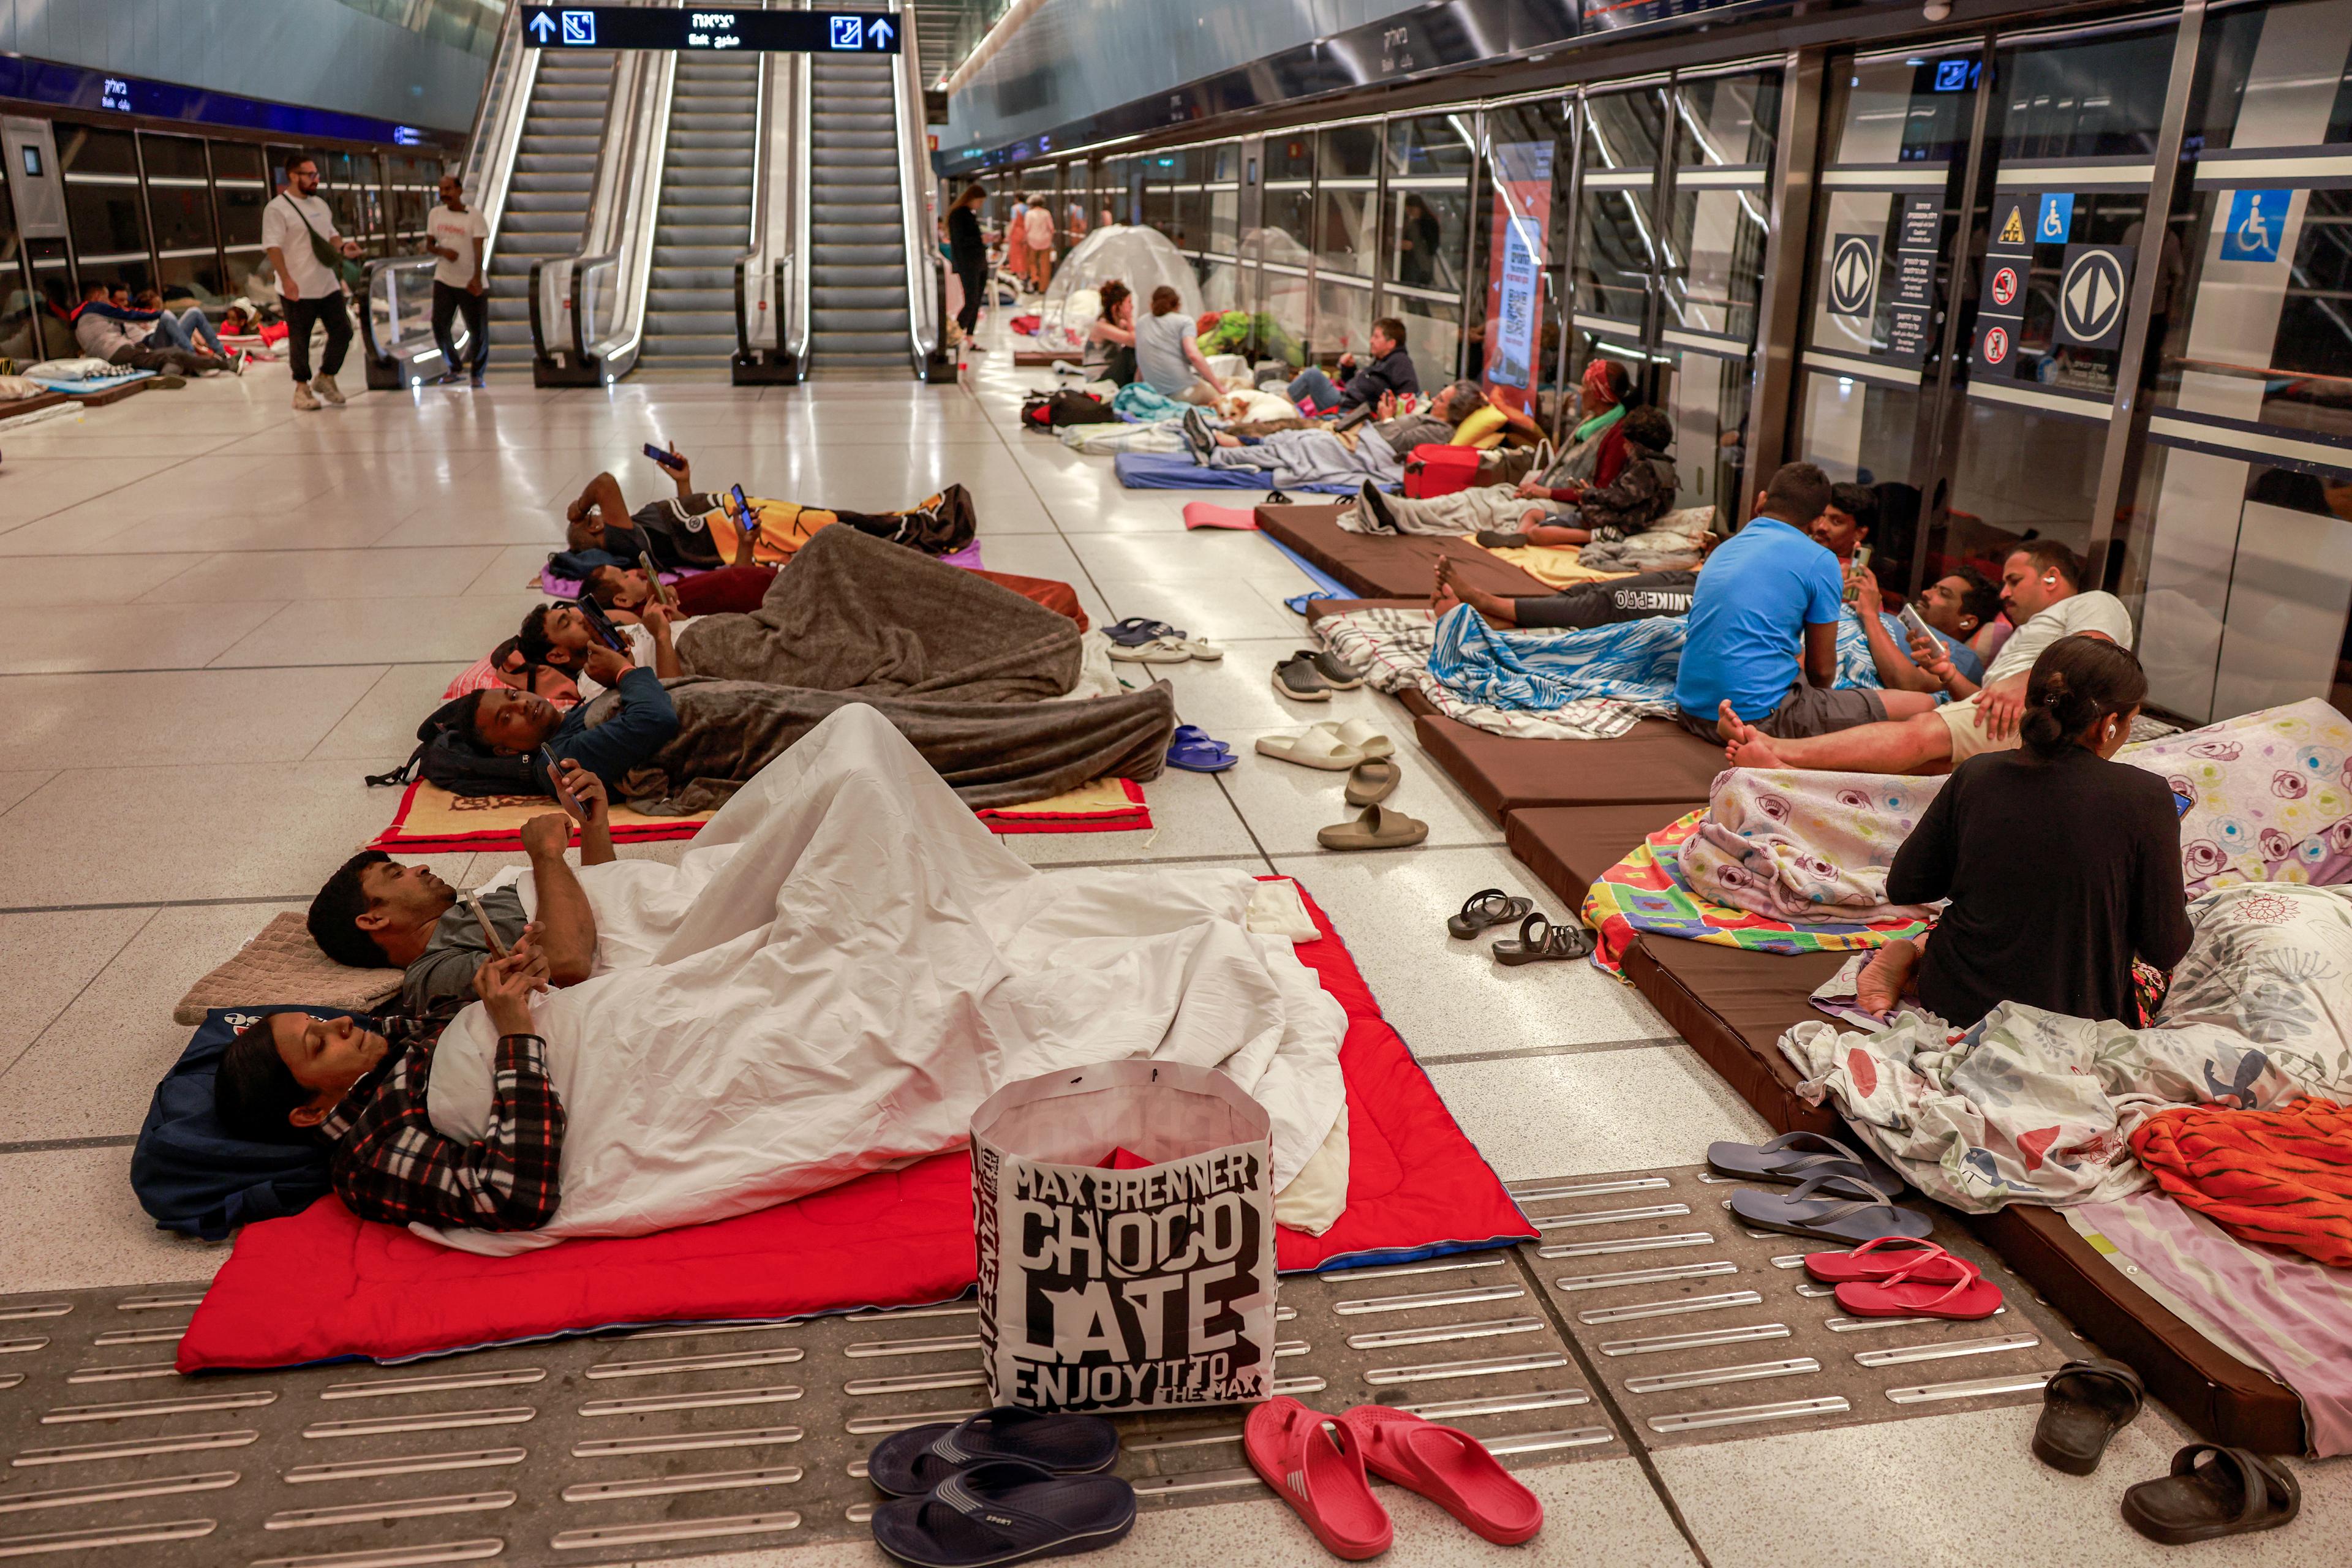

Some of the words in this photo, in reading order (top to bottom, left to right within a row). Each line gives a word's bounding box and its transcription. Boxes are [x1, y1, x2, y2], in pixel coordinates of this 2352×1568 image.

[688, 33, 710, 45] Exit
[692, 13, 734, 28] יציאה
[1014, 1164, 1088, 1207] MAX
[1099, 1152, 1253, 1211] BRENNER
[1018, 1191, 1243, 1279] CHOCO
[1013, 1261, 1237, 1365] LATE
[1012, 1360, 1152, 1408] ENJOY
[1157, 1359, 1186, 1387] IT
[1190, 1351, 1229, 1385] TO
[1159, 1385, 1203, 1403] THE
[1214, 1375, 1259, 1400] MAX
